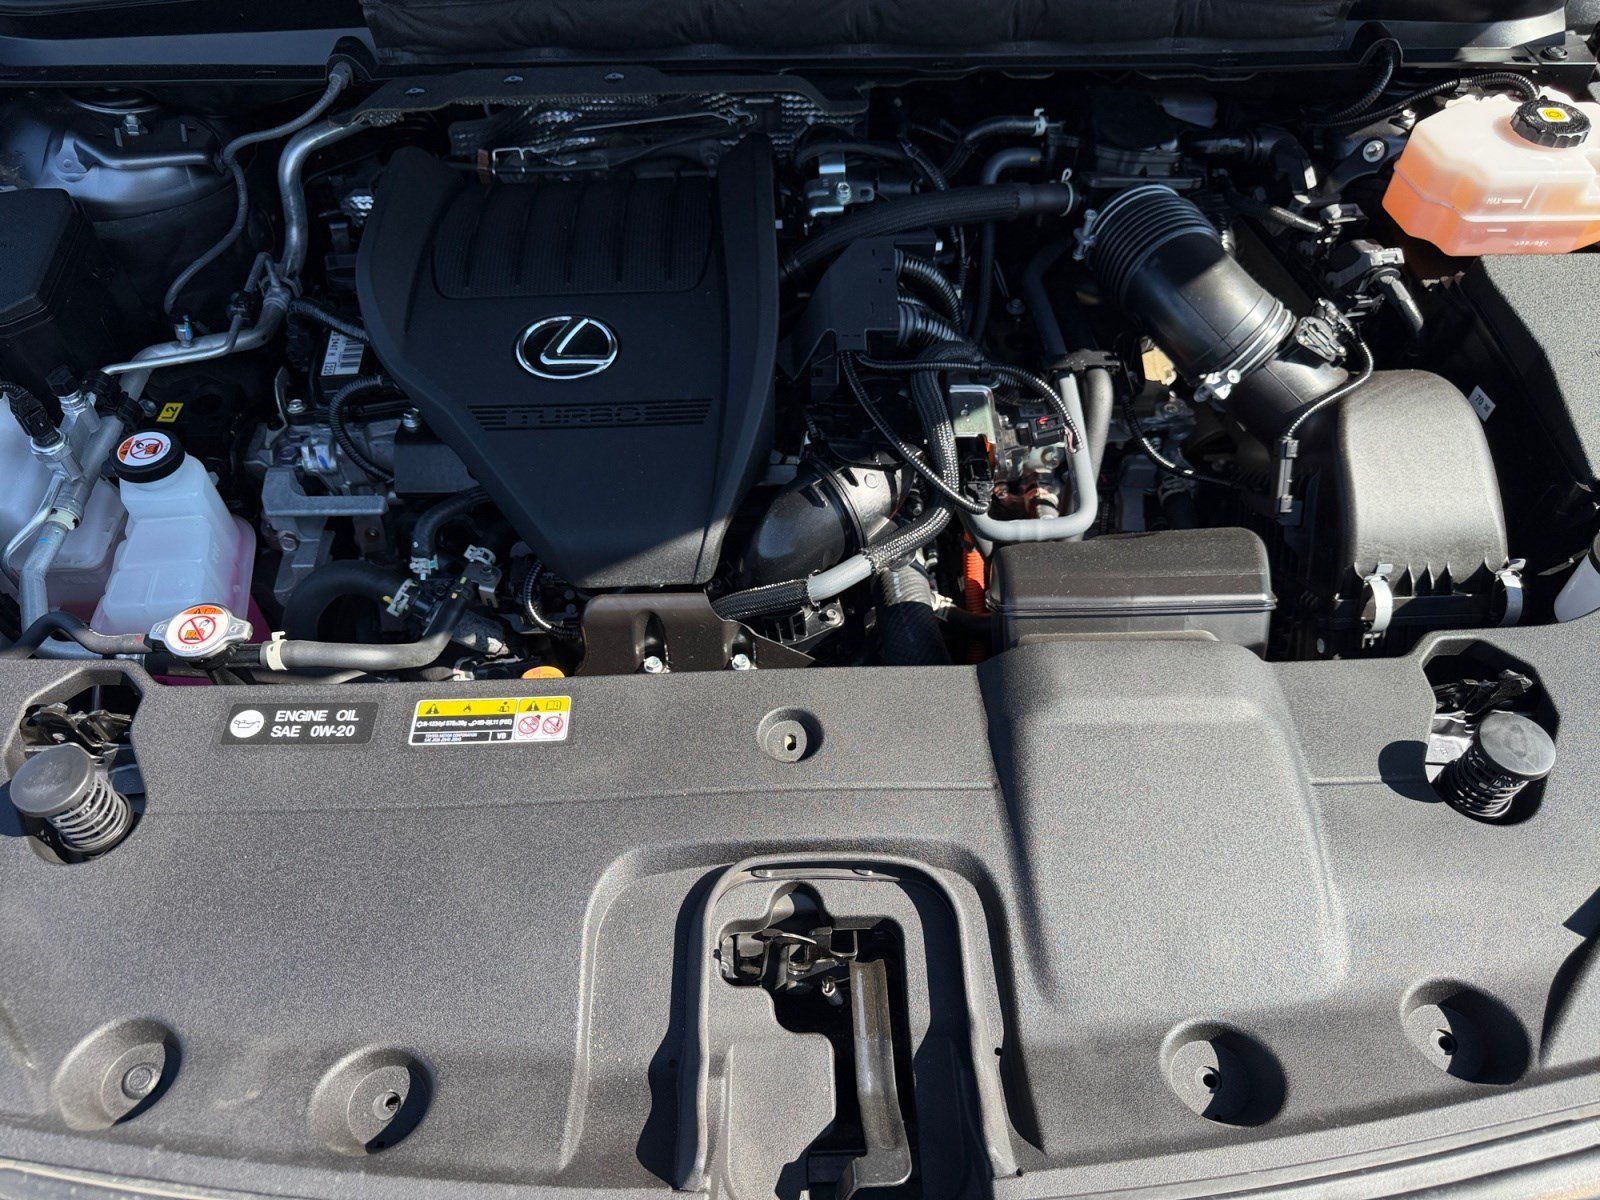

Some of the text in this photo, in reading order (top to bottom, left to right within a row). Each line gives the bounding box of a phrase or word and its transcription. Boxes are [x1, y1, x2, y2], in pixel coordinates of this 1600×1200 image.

[161, 406, 179, 419] L2
[509, 405, 641, 424] TURBO
[274, 709, 360, 722] ENGINE OIL
[270, 724, 356, 738] SAE 0W-20
